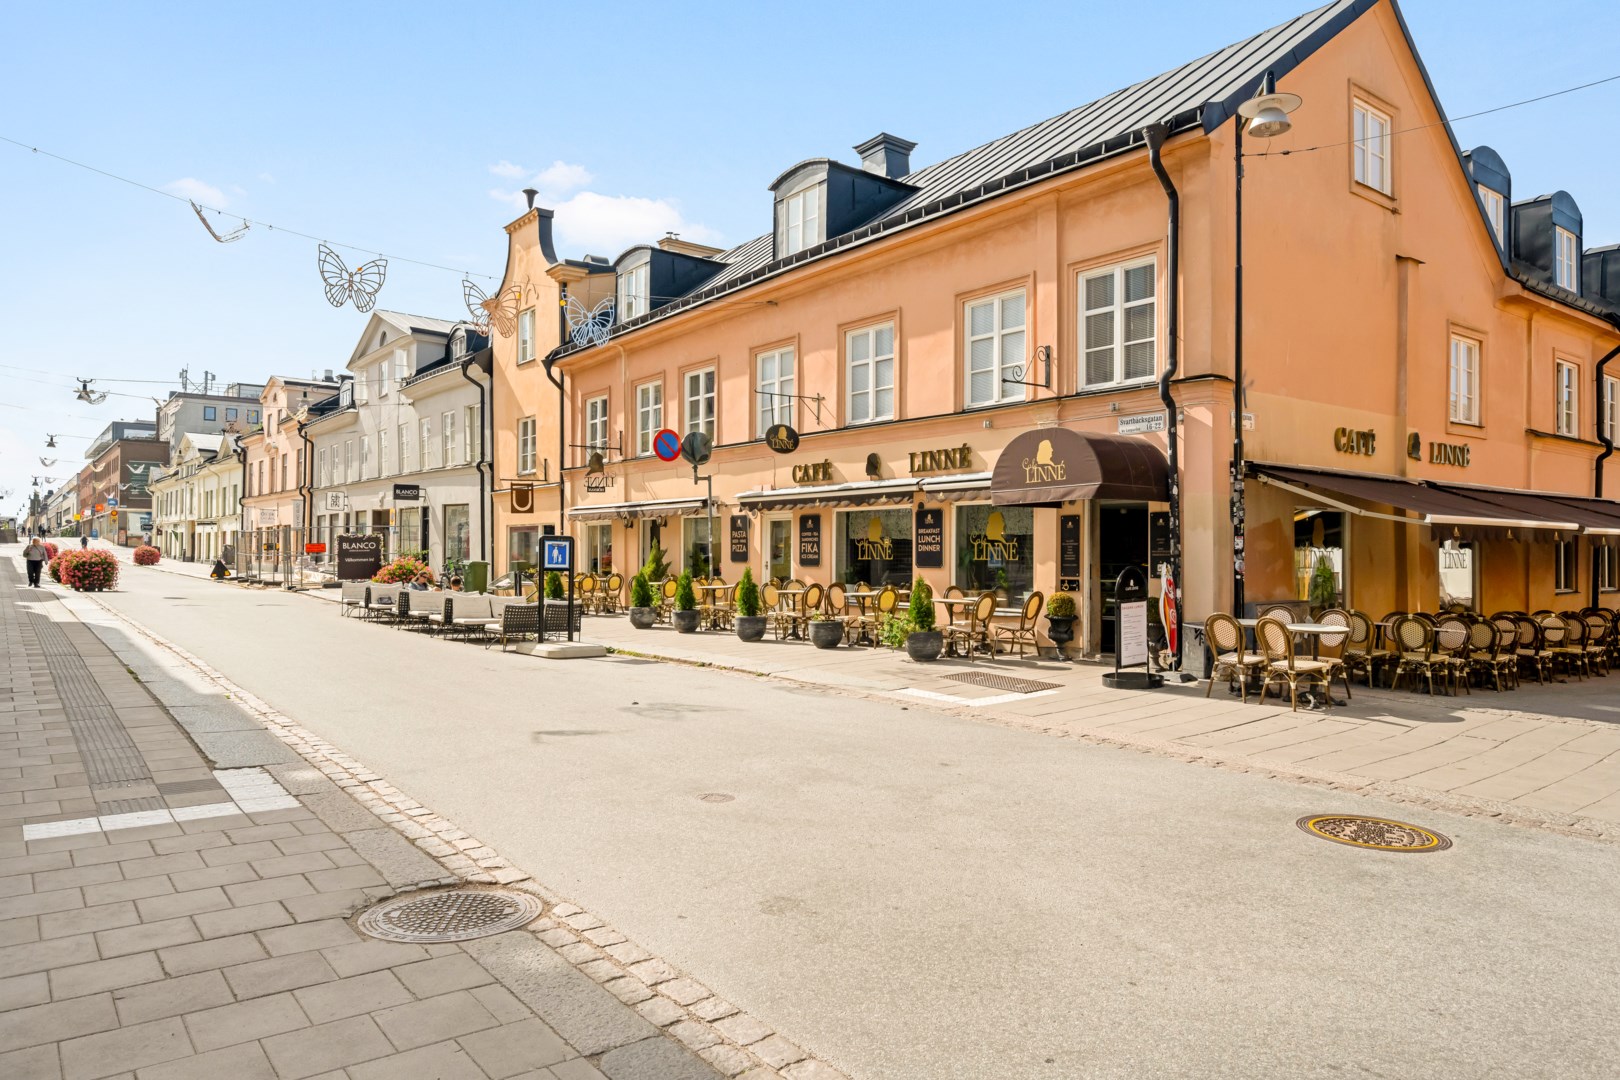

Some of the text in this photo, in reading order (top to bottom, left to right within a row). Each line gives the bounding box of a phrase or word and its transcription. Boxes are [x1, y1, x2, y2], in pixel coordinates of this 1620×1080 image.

[1119, 415, 1163, 425] Svartbäcksgatan
[1146, 422, 1161, 430] 16-22
[772, 439, 795, 450] LINNÉ
[1334, 426, 1471, 467] CAFÉ LINNÉ
[792, 443, 972, 483] CAFÉ LINNÉ
[1025, 460, 1067, 483] LINNÉ
[732, 531, 746, 539] PASTA
[918, 534, 940, 543] LUNCH
[801, 543, 818, 553] FIKA
[973, 538, 1019, 561] LINNÉ
